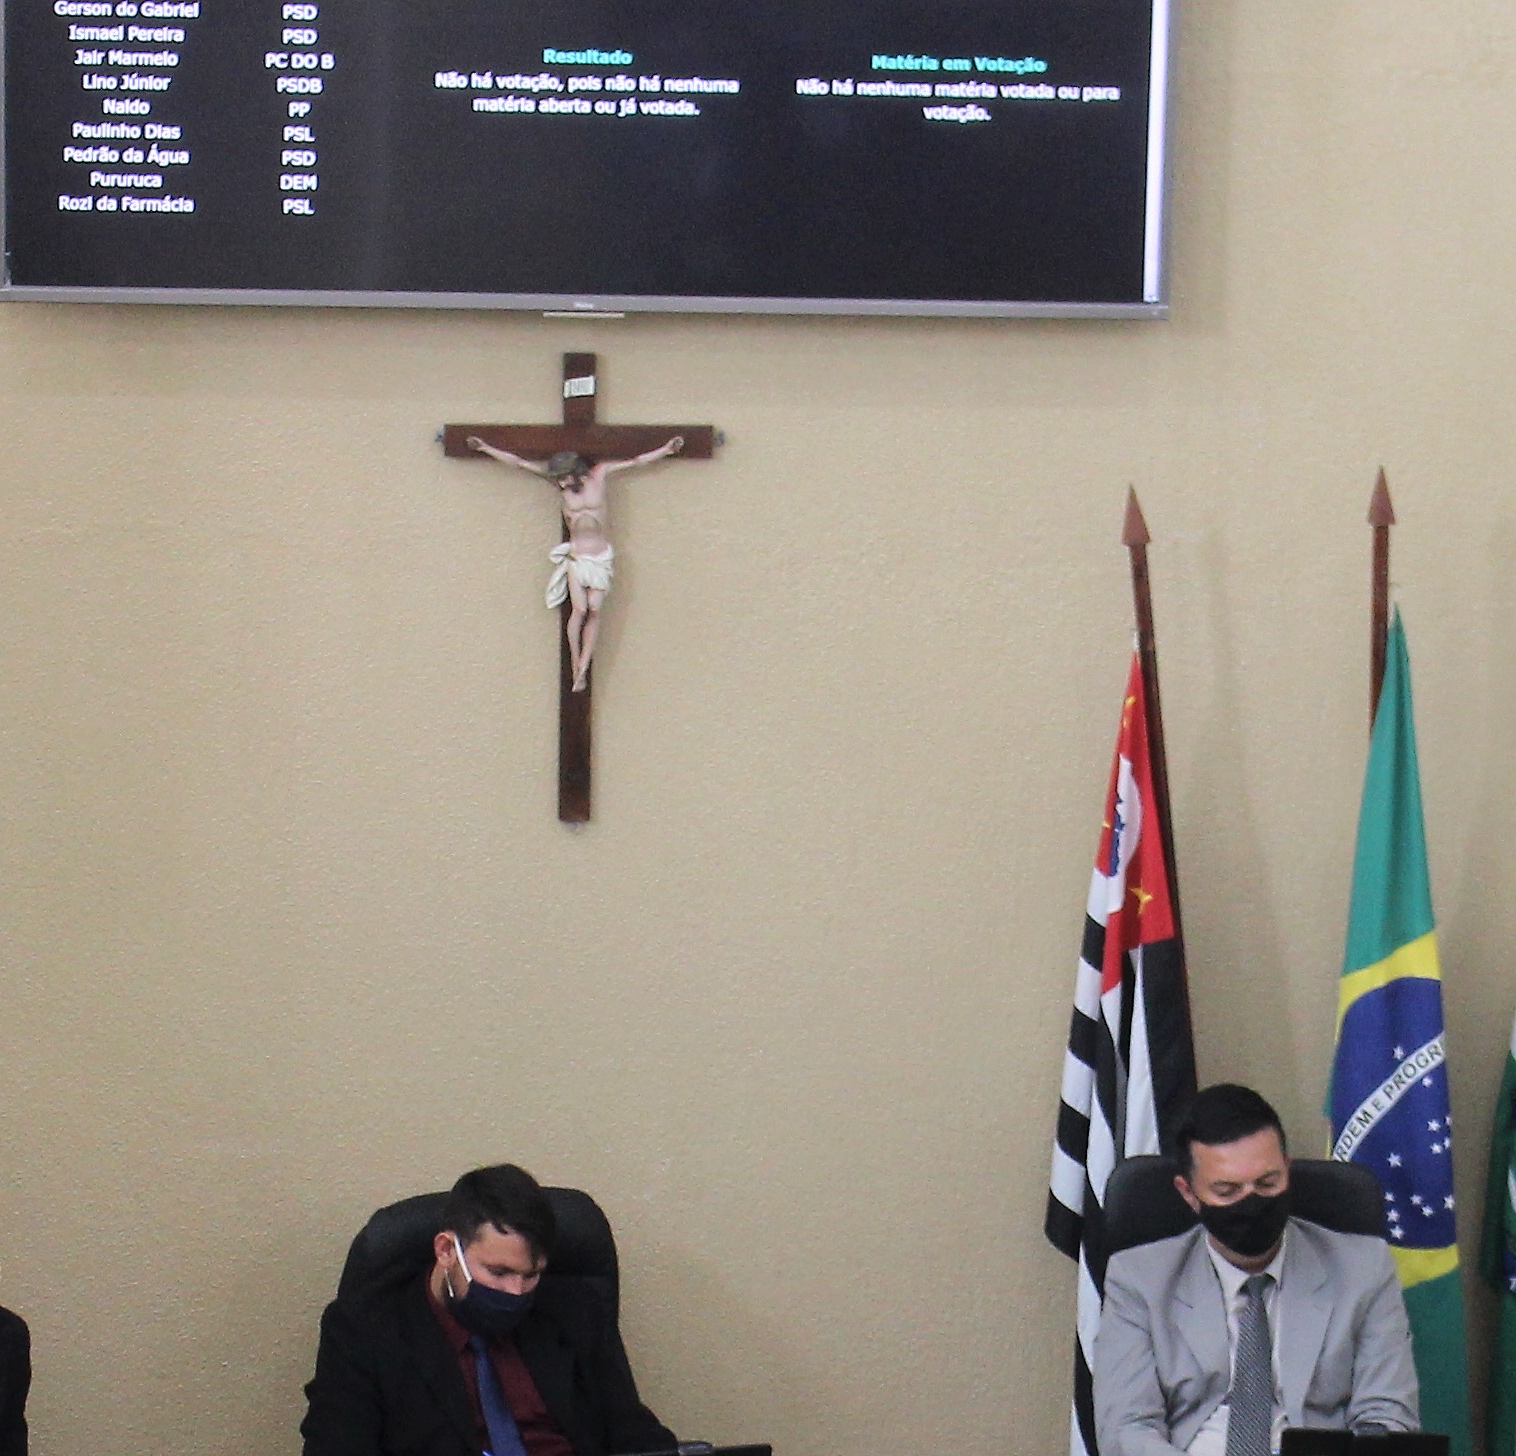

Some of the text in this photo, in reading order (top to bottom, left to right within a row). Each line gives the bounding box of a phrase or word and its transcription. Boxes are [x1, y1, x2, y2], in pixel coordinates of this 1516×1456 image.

[53, 0, 200, 18] Gerson do Gabriel
[282, 3, 319, 21] PSD
[68, 23, 186, 43] Ismael Pereira
[282, 27, 318, 45] PSD
[74, 48, 180, 67] Jair Marmelo
[264, 51, 336, 70] PC DO B
[543, 47, 634, 65] Resultado
[871, 53, 1048, 75] Matéria em Votação
[82, 71, 172, 91] Lino Júnior
[276, 75, 324, 94] PSDB
[434, 70, 741, 94] Não há votação, pois não há nenhuma
[795, 77, 1121, 103] Não há nenhuma matéria votada ou para
[102, 97, 151, 115] Naldo
[288, 100, 312, 118] PP
[472, 94, 701, 118] matéria aberta ou já votada.
[922, 103, 992, 124] votação.
[72, 121, 182, 140] Paulinho Dias
[283, 124, 316, 142] PSL
[63, 142, 190, 167] Pedrão da Água
[281, 149, 317, 167] PSD
[90, 170, 163, 188] Pururuca
[279, 173, 318, 191] DEM
[58, 194, 195, 213] Rozi da Farmácia
[282, 197, 316, 215] PSL
[1334, 1043, 1443, 1162] RDEM E PROGR
